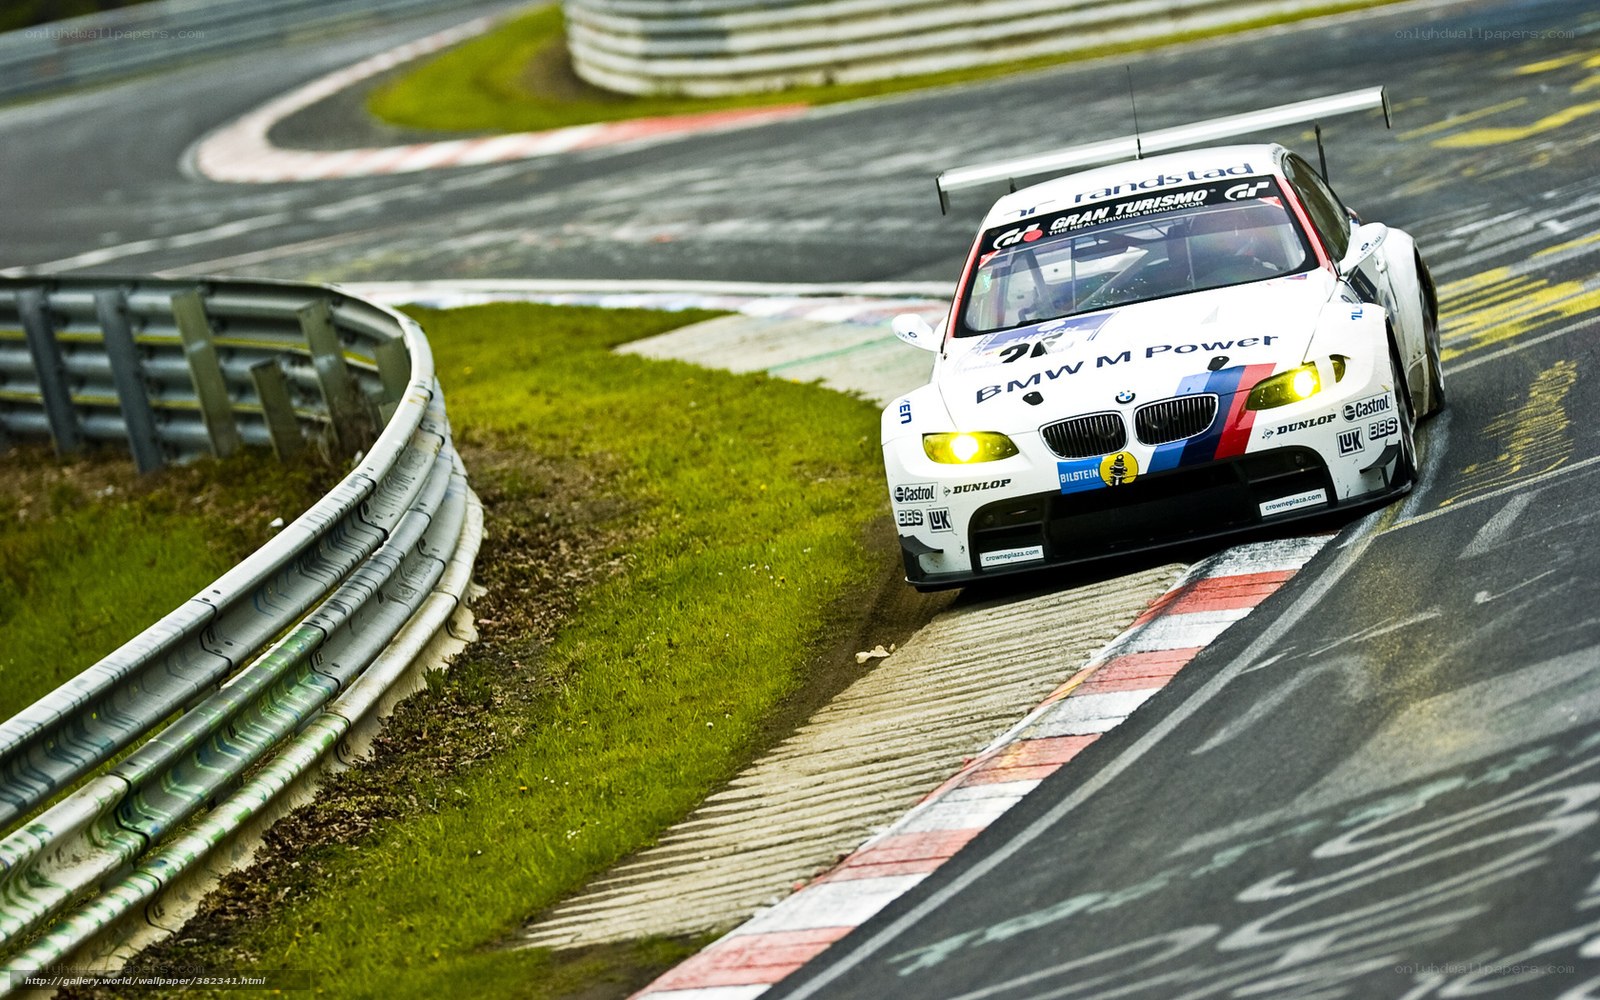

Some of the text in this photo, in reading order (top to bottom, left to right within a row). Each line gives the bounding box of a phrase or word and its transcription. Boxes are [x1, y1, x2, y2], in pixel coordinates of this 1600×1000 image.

[1074, 163, 1254, 203] randstad
[1048, 202, 1203, 236] THE REAL DRIVING SIMULATOR
[1051, 189, 1208, 230] GRAN TURISMO
[976, 361, 1084, 404] BMW
[1096, 351, 1131, 368] M
[1145, 336, 1278, 358] Power
[1355, 395, 1389, 418] Castrol
[1277, 414, 1336, 435] DUNLOP
[1369, 417, 1397, 441] BBS
[953, 478, 1011, 494] DUNLOP
[1060, 468, 1100, 483] BILSTEIN
[904, 485, 935, 501] Castrol
[1265, 493, 1322, 511] crowneplaza.com
[898, 510, 923, 526] BBS
[985, 549, 1039, 562] crowneplaza.com
